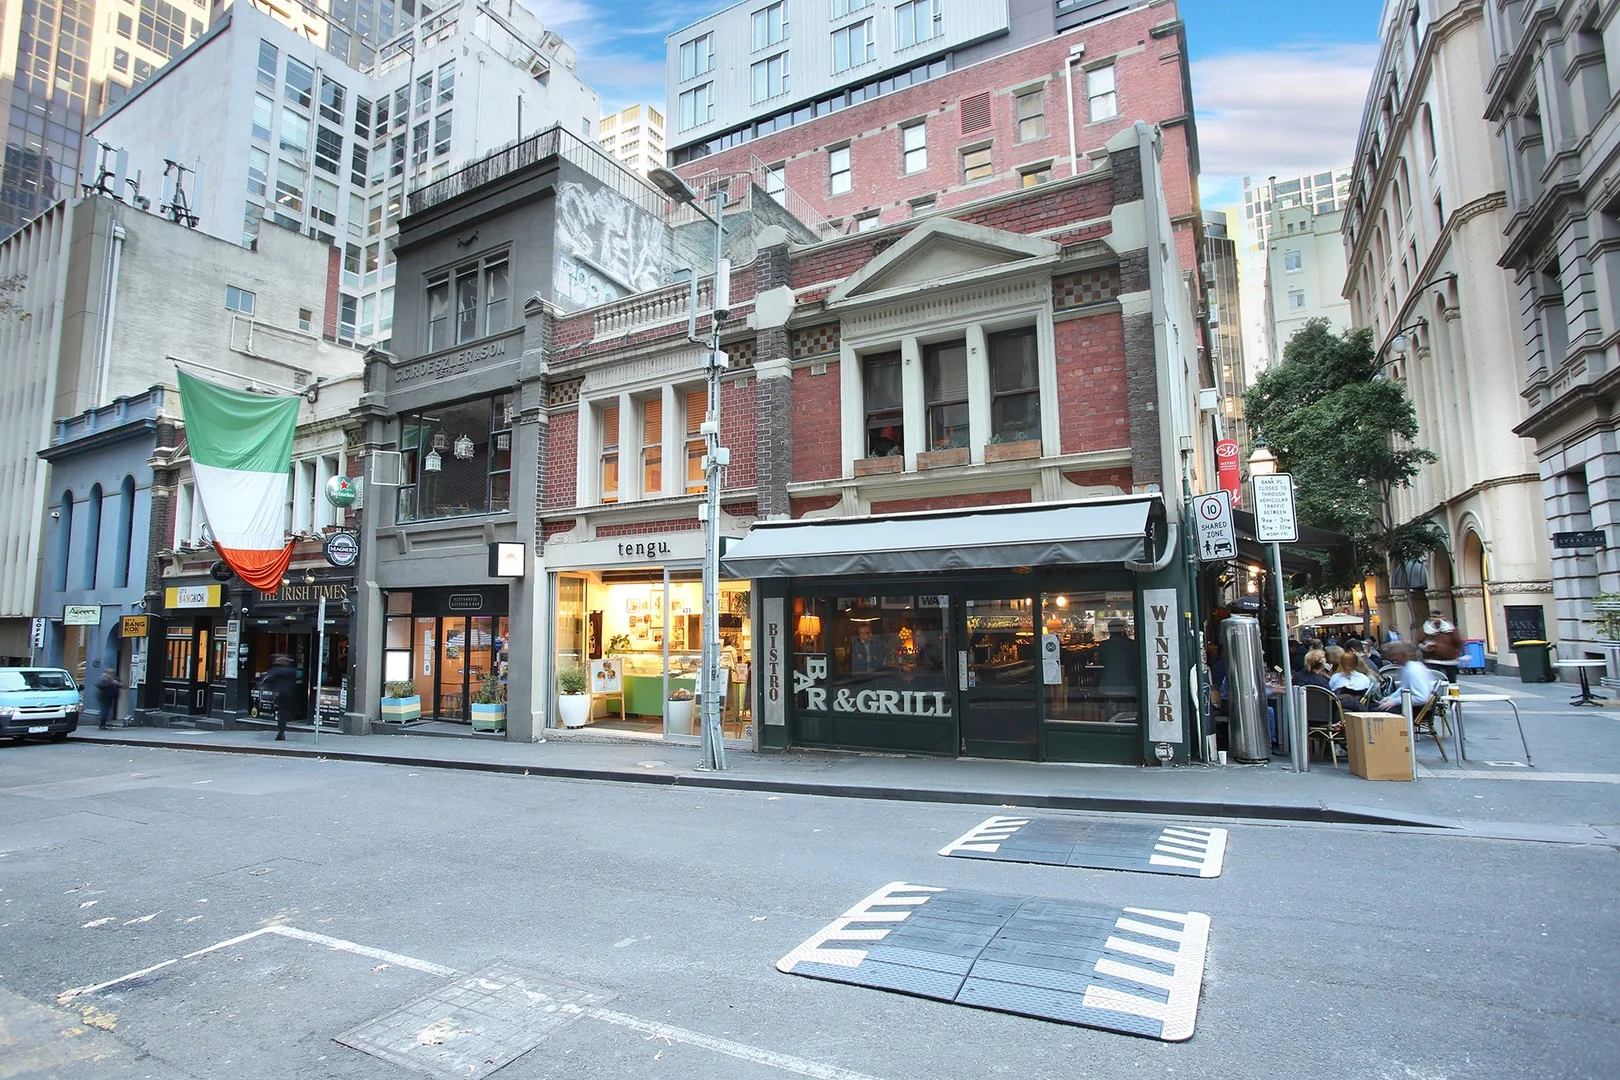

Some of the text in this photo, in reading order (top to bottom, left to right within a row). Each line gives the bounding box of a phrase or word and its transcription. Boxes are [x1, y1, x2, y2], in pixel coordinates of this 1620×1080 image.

[1206, 504, 1217, 515] 10
[1201, 521, 1227, 532] SHARED
[1206, 530, 1224, 538] ZONE
[281, 585, 310, 601] IRISH
[313, 583, 347, 600] TIMES
[179, 593, 206, 603] BANGKOK
[768, 623, 780, 701] BISTRO
